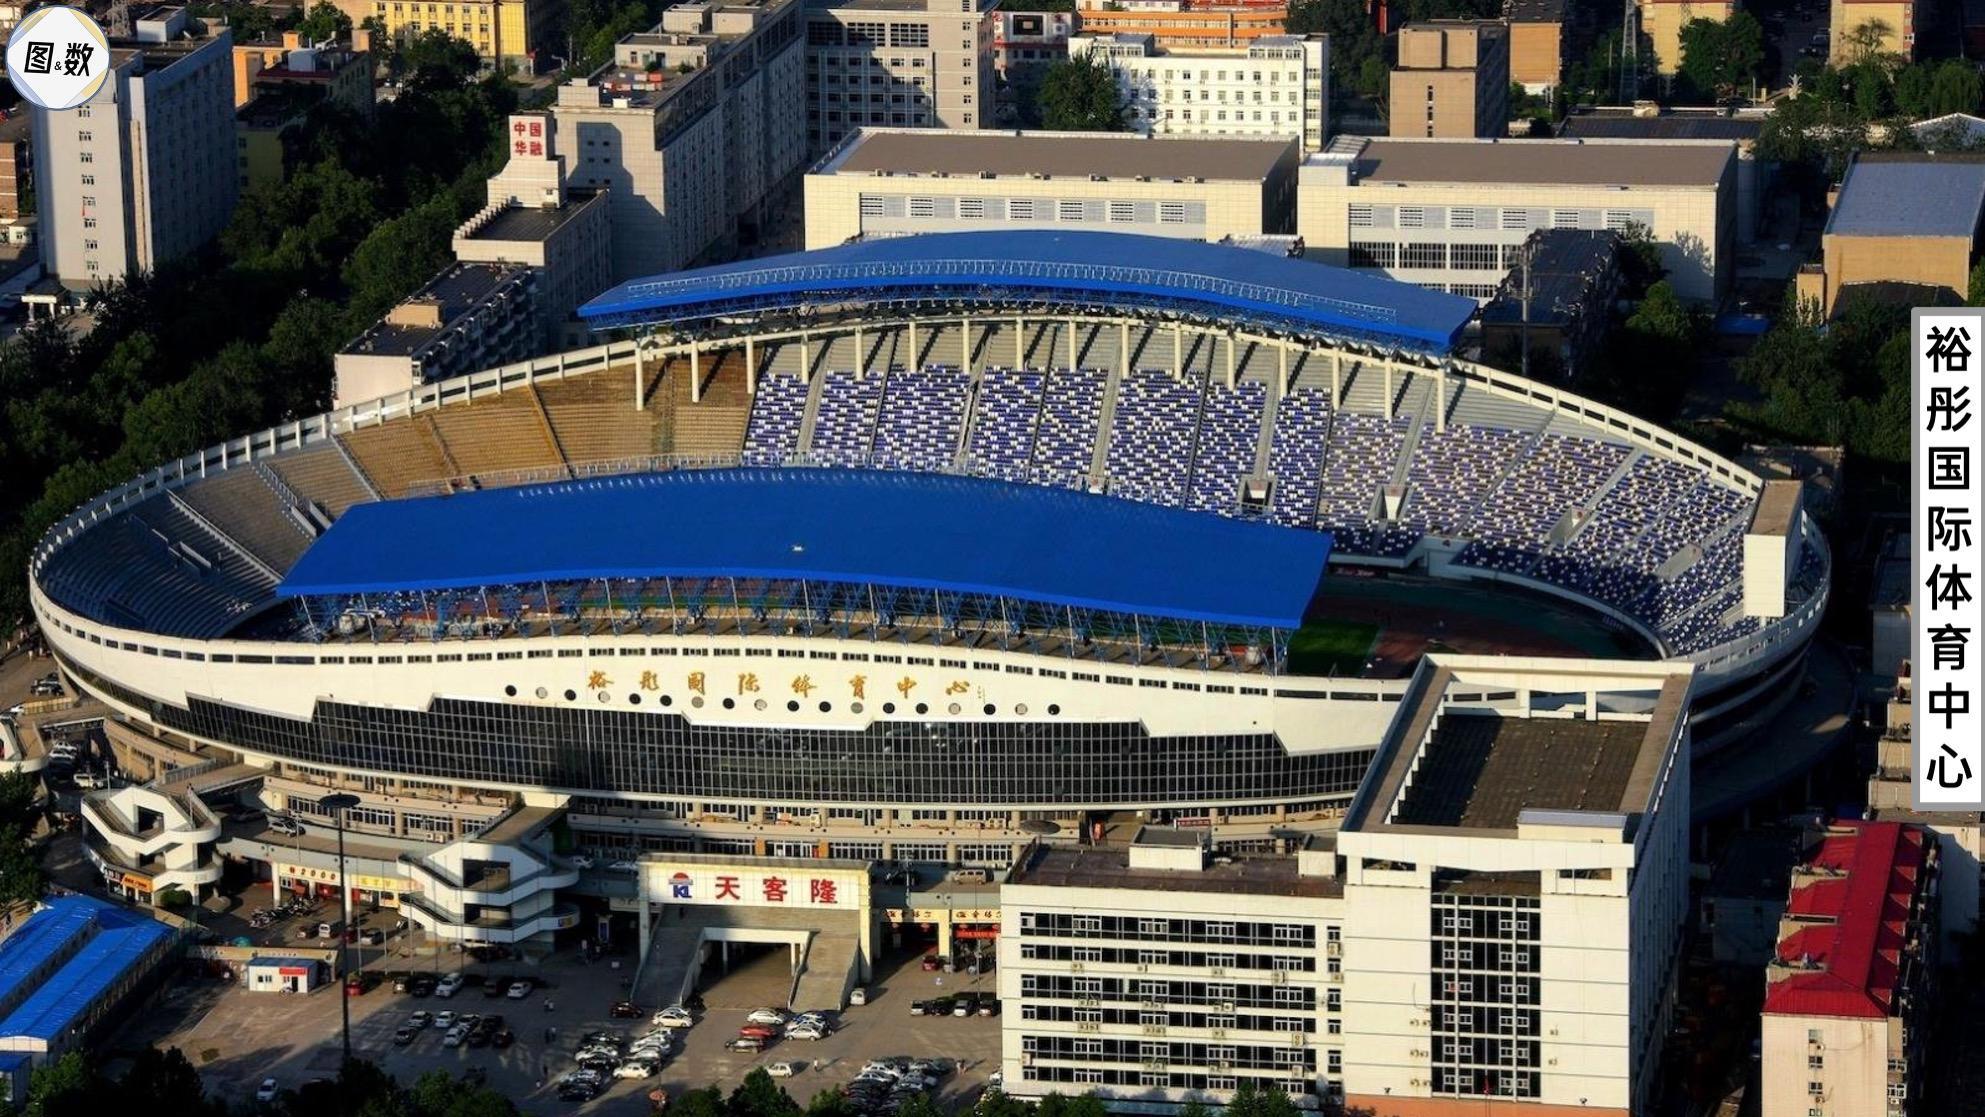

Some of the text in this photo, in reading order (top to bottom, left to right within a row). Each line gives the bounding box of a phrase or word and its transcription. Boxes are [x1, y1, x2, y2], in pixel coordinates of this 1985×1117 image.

[514, 121, 542, 137] 中国
[715, 876, 838, 904] 天客隆
